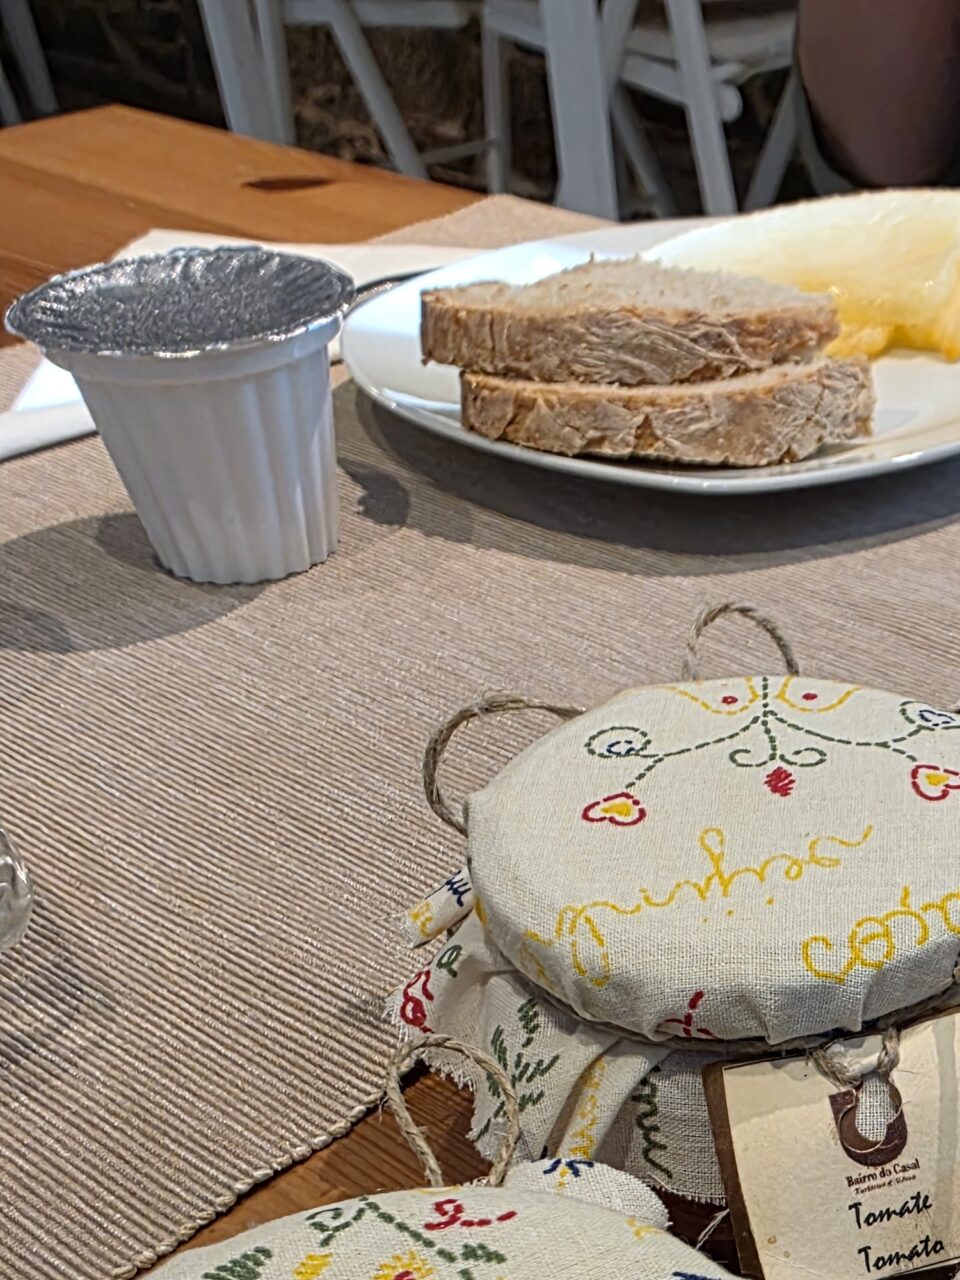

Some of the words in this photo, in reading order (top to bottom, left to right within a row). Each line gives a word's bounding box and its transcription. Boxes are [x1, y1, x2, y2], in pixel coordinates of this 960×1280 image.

[845, 1172, 878, 1188] Bairro
[879, 1167, 892, 1179] do
[893, 1158, 921, 1175] Casal
[848, 1191, 933, 1230] Tomate
[857, 1234, 945, 1273] Tomato
